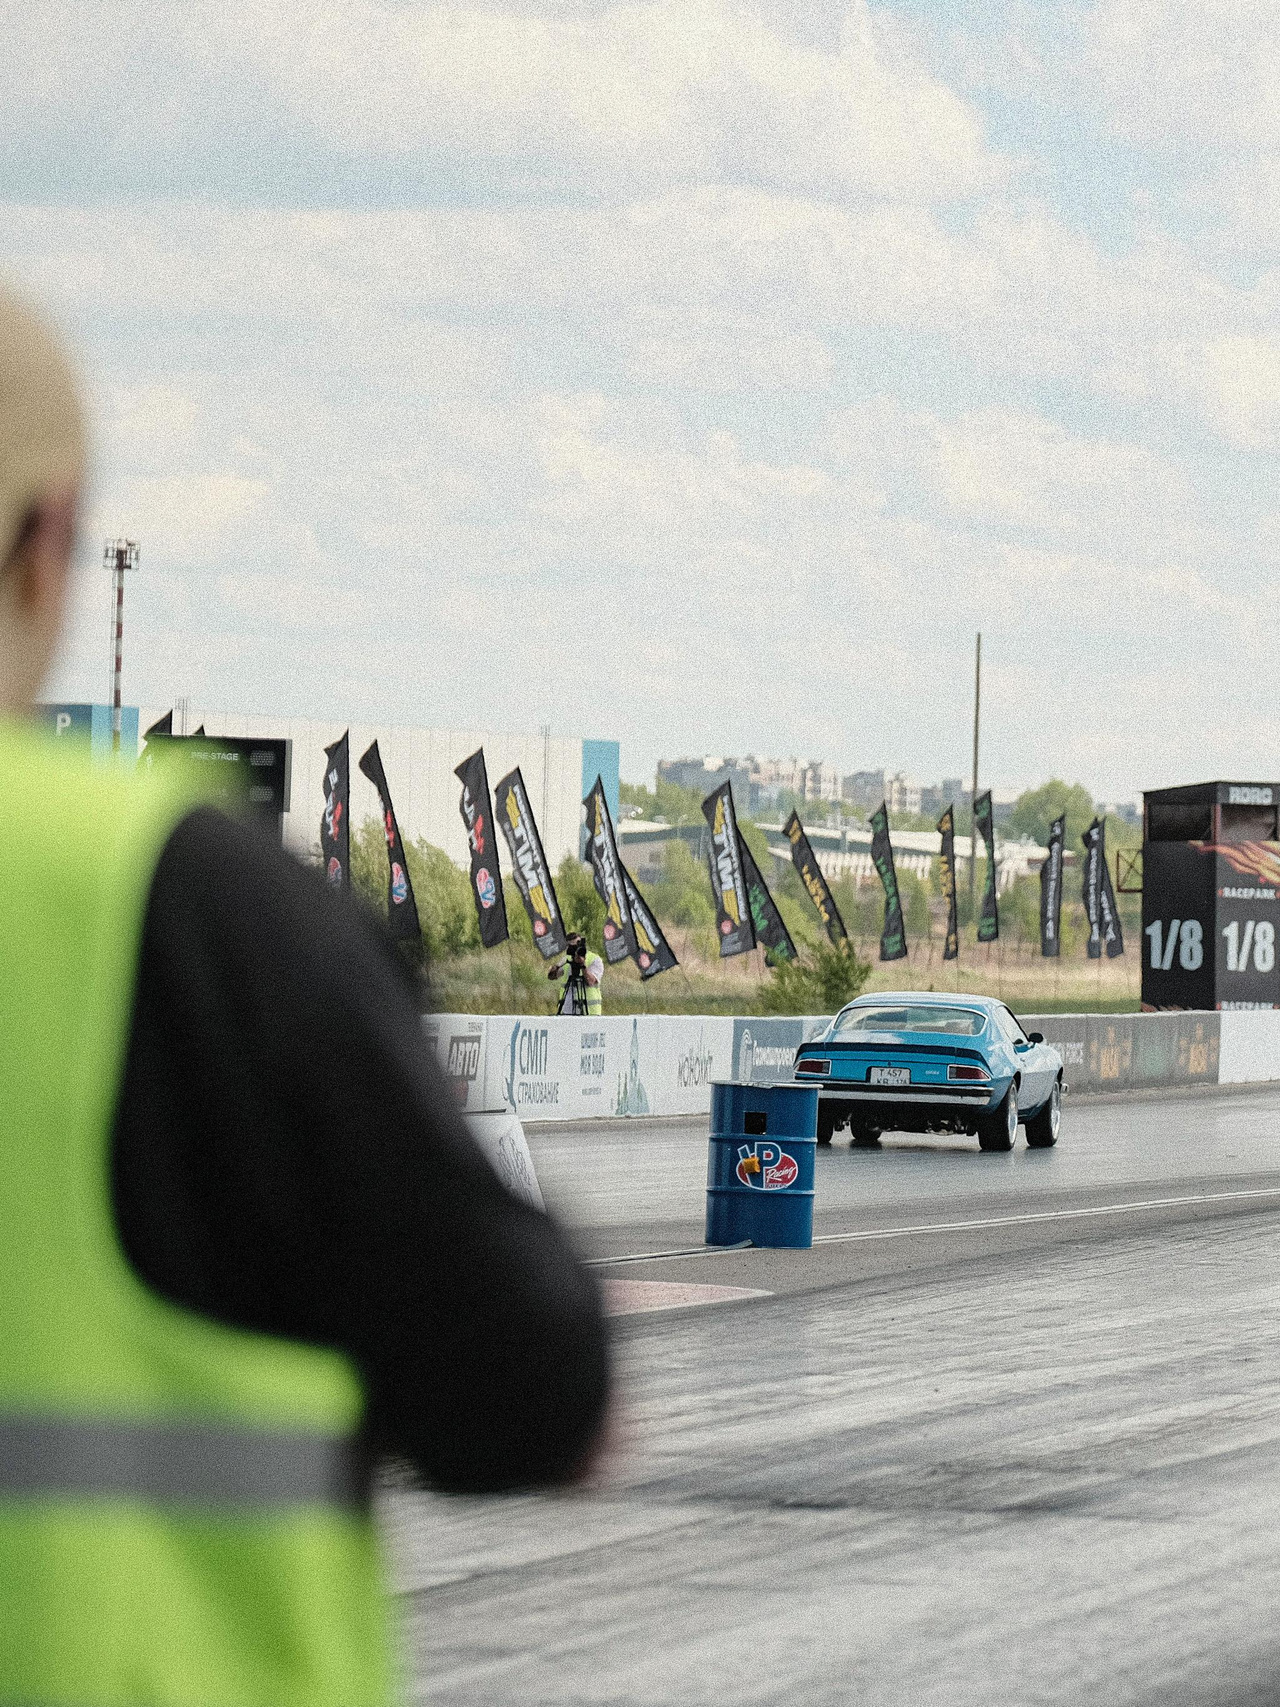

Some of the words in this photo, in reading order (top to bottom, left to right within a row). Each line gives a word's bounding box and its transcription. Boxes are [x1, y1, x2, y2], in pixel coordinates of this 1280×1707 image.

[1223, 886, 1276, 899] RACEPARK
[1145, 919, 1204, 971] 1/8
[1222, 920, 1275, 973] 1/8
[519, 1028, 549, 1075] СМП
[766, 1166, 796, 1183] Racing
